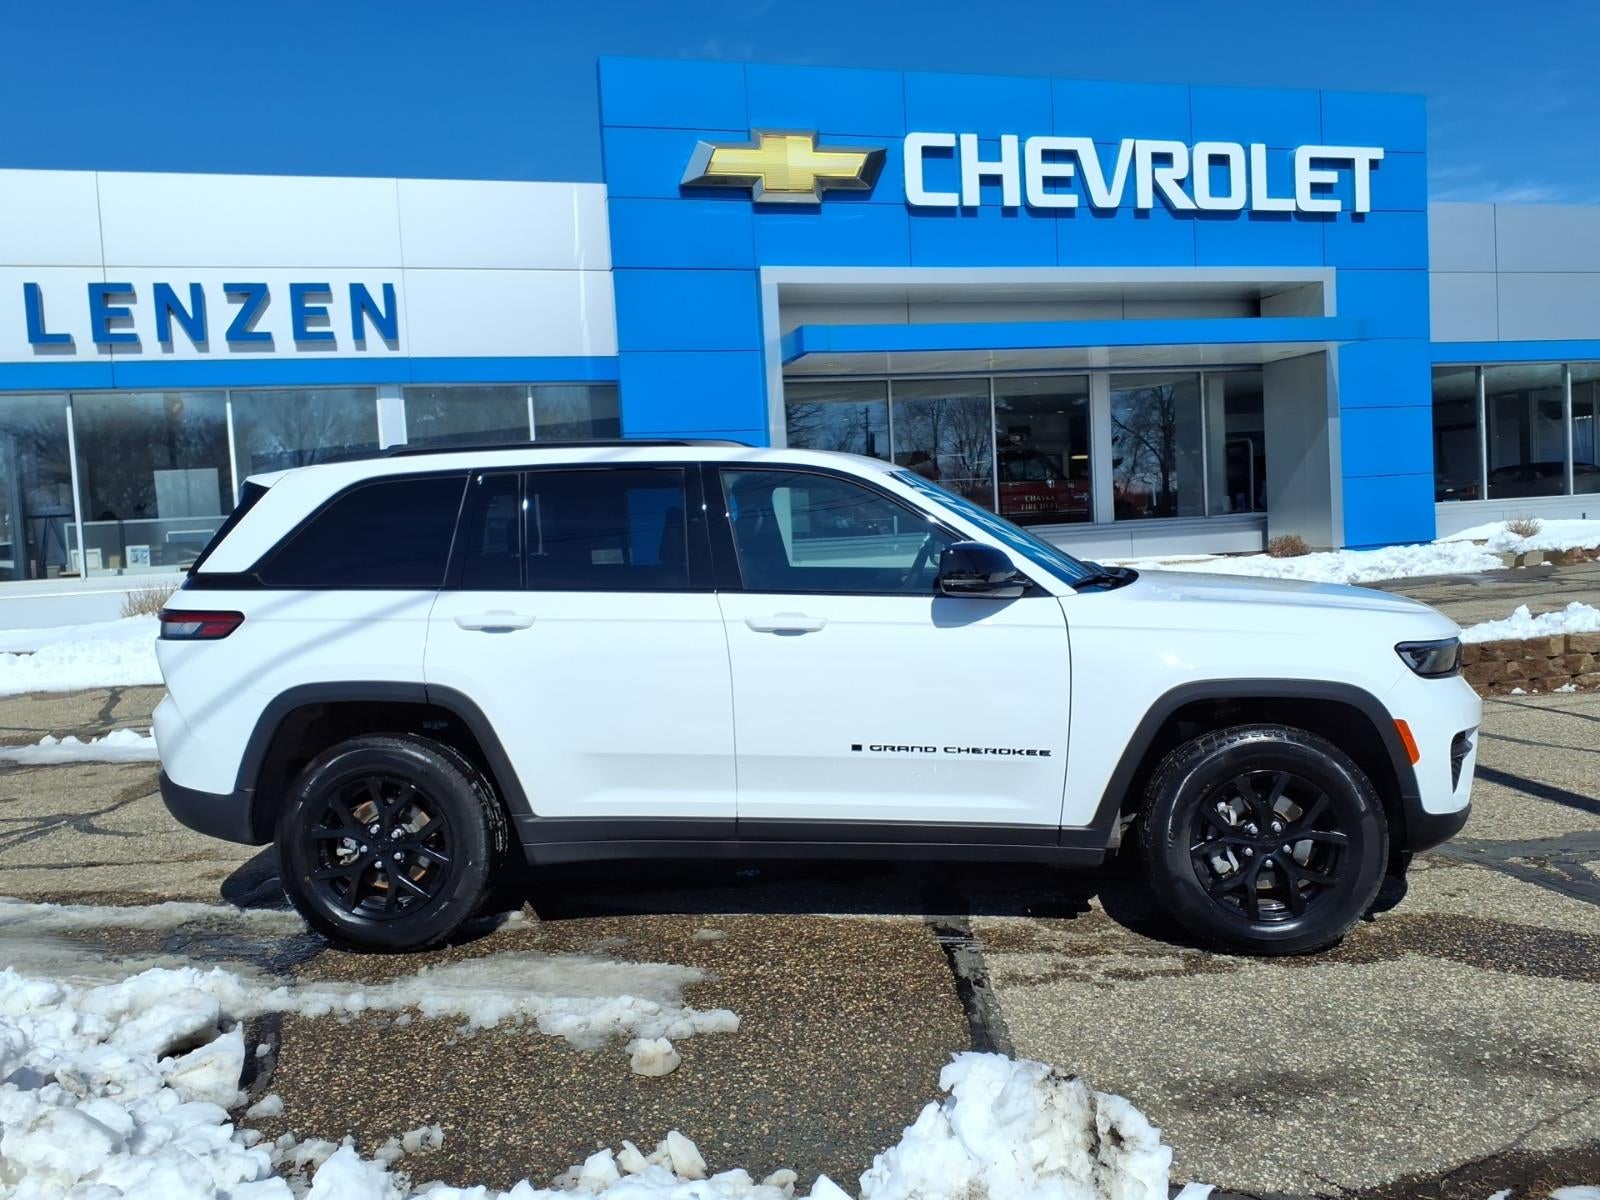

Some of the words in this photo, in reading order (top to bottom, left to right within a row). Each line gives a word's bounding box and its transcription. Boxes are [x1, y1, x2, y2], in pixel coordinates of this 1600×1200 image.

[904, 132, 1385, 213] CHEVROLET
[23, 282, 400, 346] LENZEN
[869, 744, 937, 753] GRAND
[943, 746, 1051, 757] CHEROKEE
